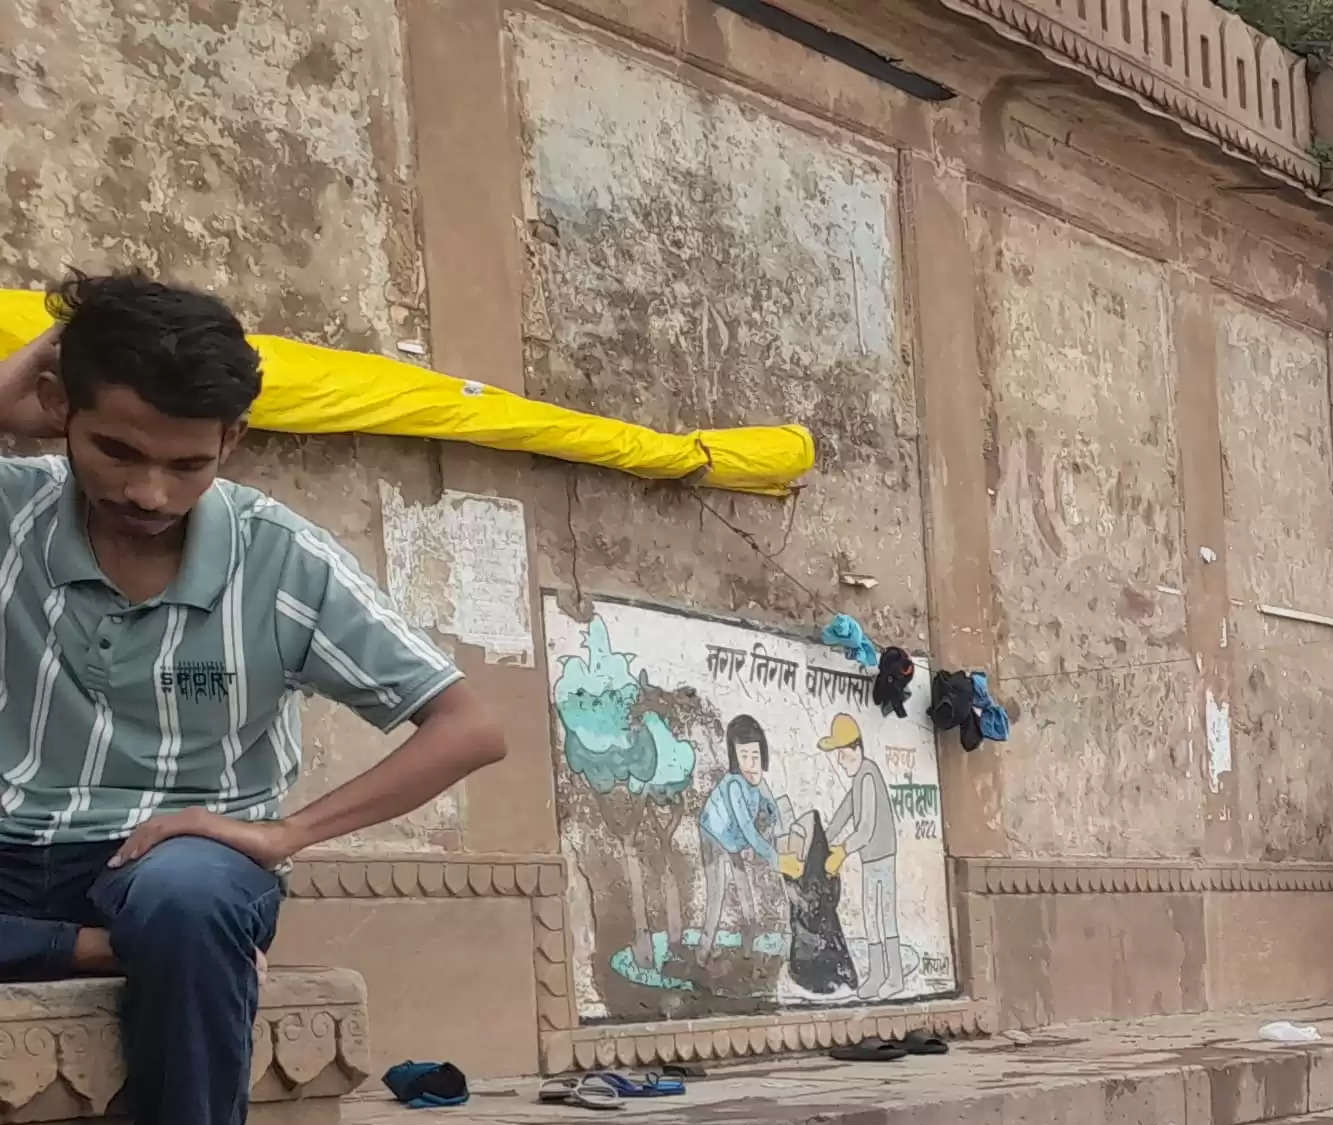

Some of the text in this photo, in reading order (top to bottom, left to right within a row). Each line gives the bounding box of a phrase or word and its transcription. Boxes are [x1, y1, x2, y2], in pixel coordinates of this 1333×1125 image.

[160, 671, 238, 687] SPORT
[706, 644, 752, 699] नगर
[750, 642, 799, 692] निगम
